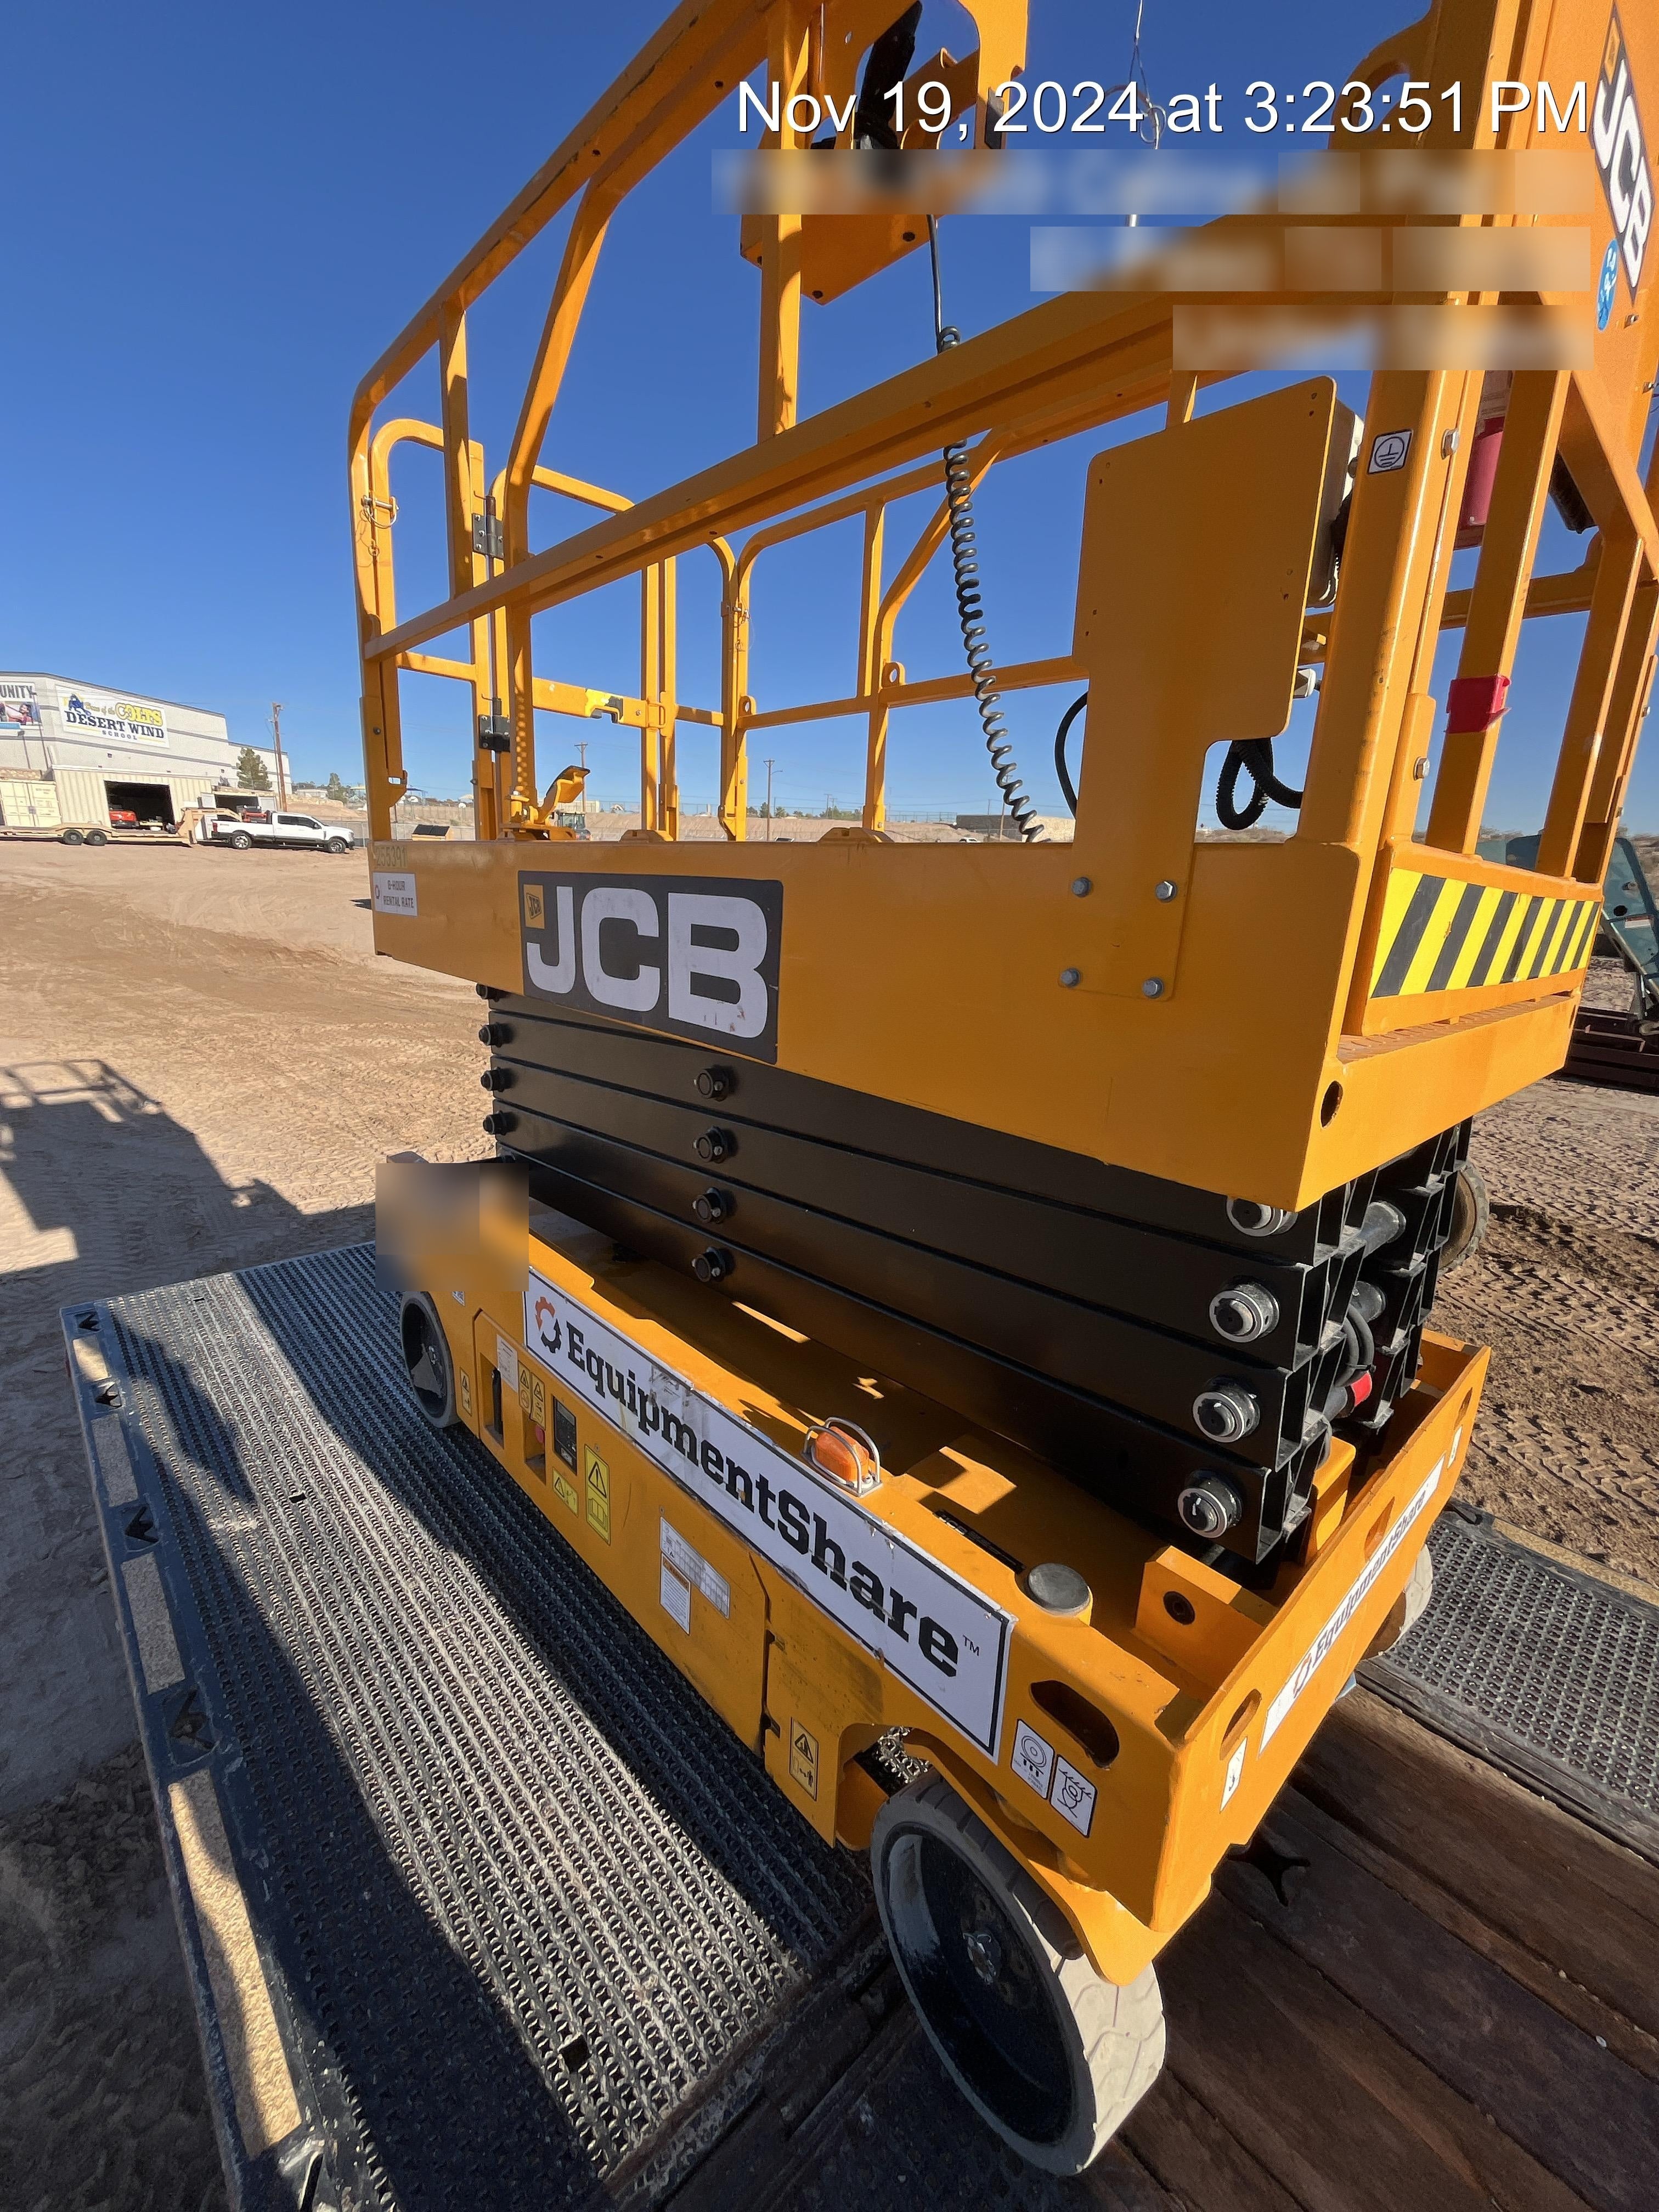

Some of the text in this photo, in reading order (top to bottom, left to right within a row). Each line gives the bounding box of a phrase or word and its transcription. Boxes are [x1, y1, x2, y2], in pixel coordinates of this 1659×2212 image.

[1593, 59, 1651, 288] JCB
[64, 710, 165, 738] DESERT WIND
[115, 702, 163, 726] COLTS
[102, 730, 138, 740] SCHOOL
[402, 897, 414, 908] RATE
[527, 885, 768, 1039] JCB
[566, 1321, 958, 1678] EquipmentShare
